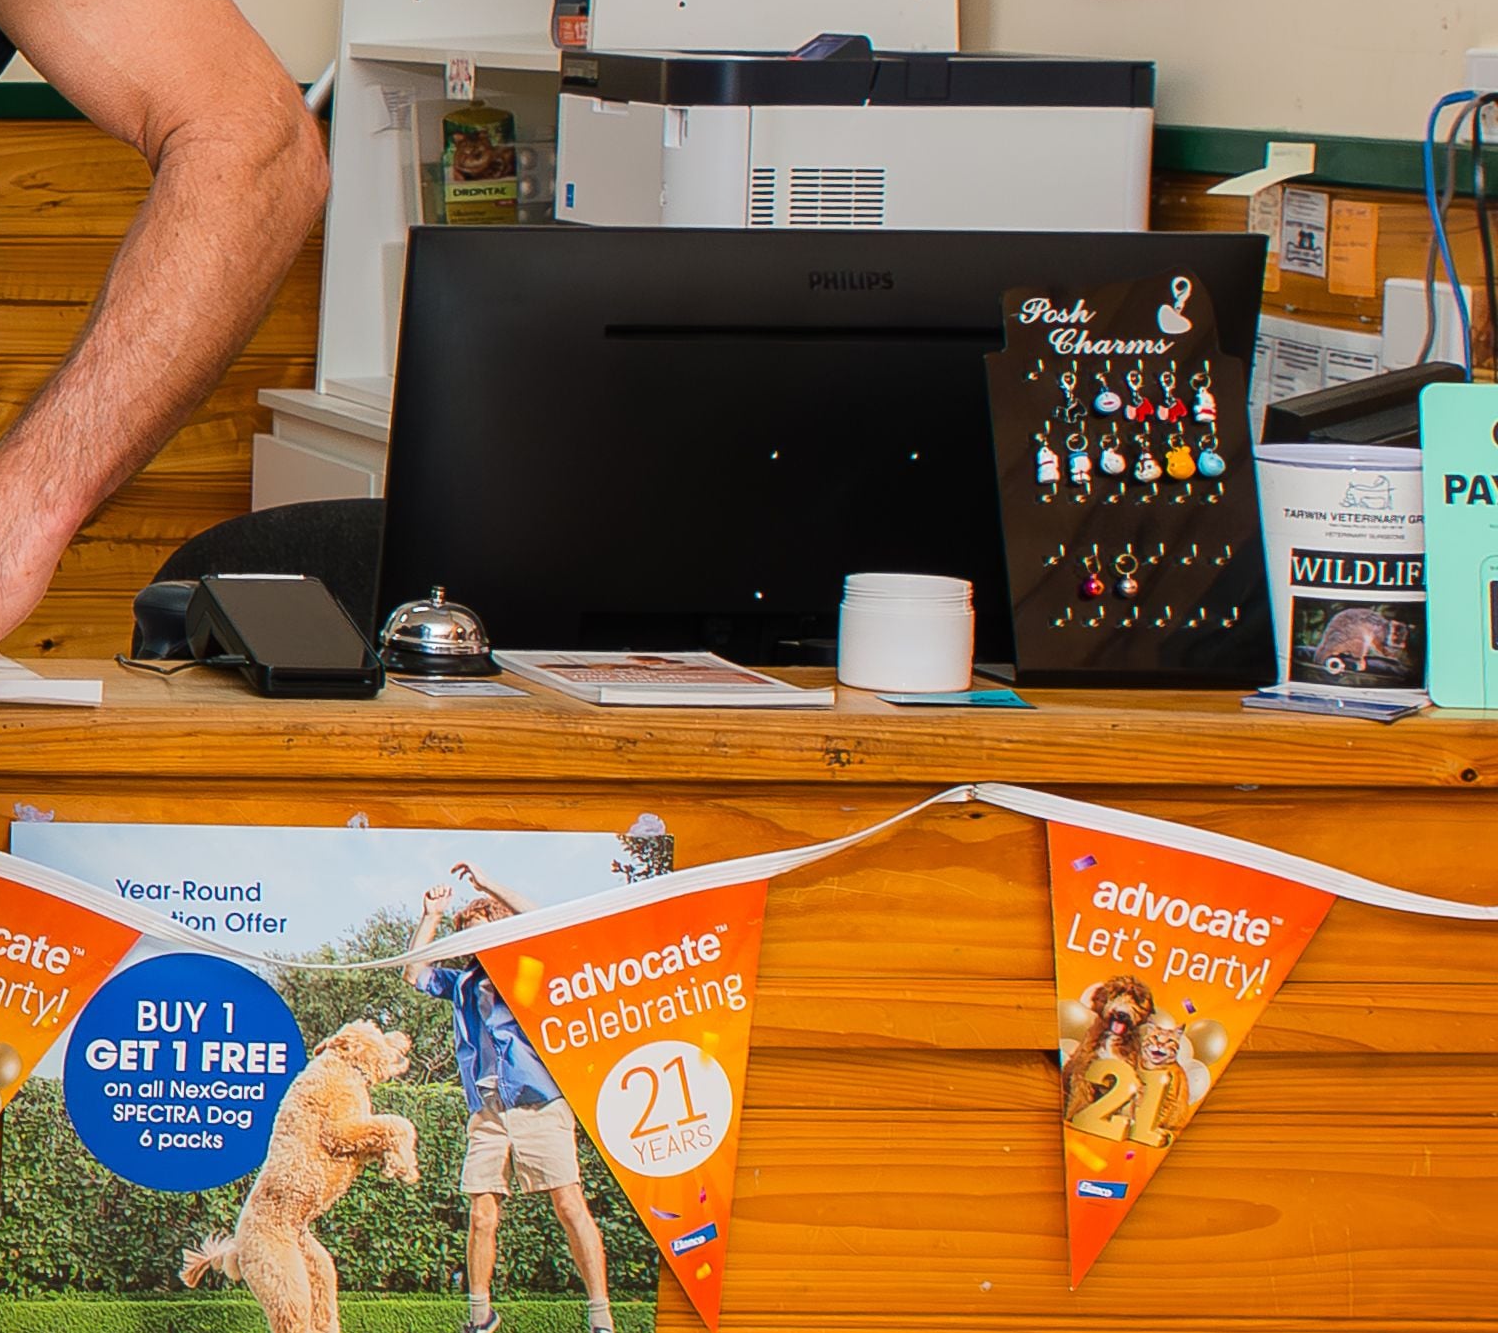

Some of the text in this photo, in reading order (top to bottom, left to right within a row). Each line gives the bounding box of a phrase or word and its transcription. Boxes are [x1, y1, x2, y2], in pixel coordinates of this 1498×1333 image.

[809, 271, 894, 291] PHILIPS
[1019, 297, 1096, 324] Posh
[1048, 328, 1175, 356] Charms
[1283, 508, 1327, 520] TARWIN
[1330, 511, 1406, 524] VETERINARY
[1292, 556, 1422, 586] WILDLIF
[115, 879, 262, 902] Year-Round
[225, 912, 288, 933] Offer
[1066, 913, 1271, 1001] Let's party!
[137, 1001, 234, 1033] BUY 1
[540, 972, 747, 1055] Celebrating
[85, 1039, 287, 1074] GET 1 FREE
[104, 1079, 265, 1100] on all NexGard
[620, 1055, 708, 1140] 21
[112, 1104, 252, 1129] SPECTRA Dog
[139, 1130, 223, 1151] 6 packs
[632, 1125, 713, 1166] YEARS
